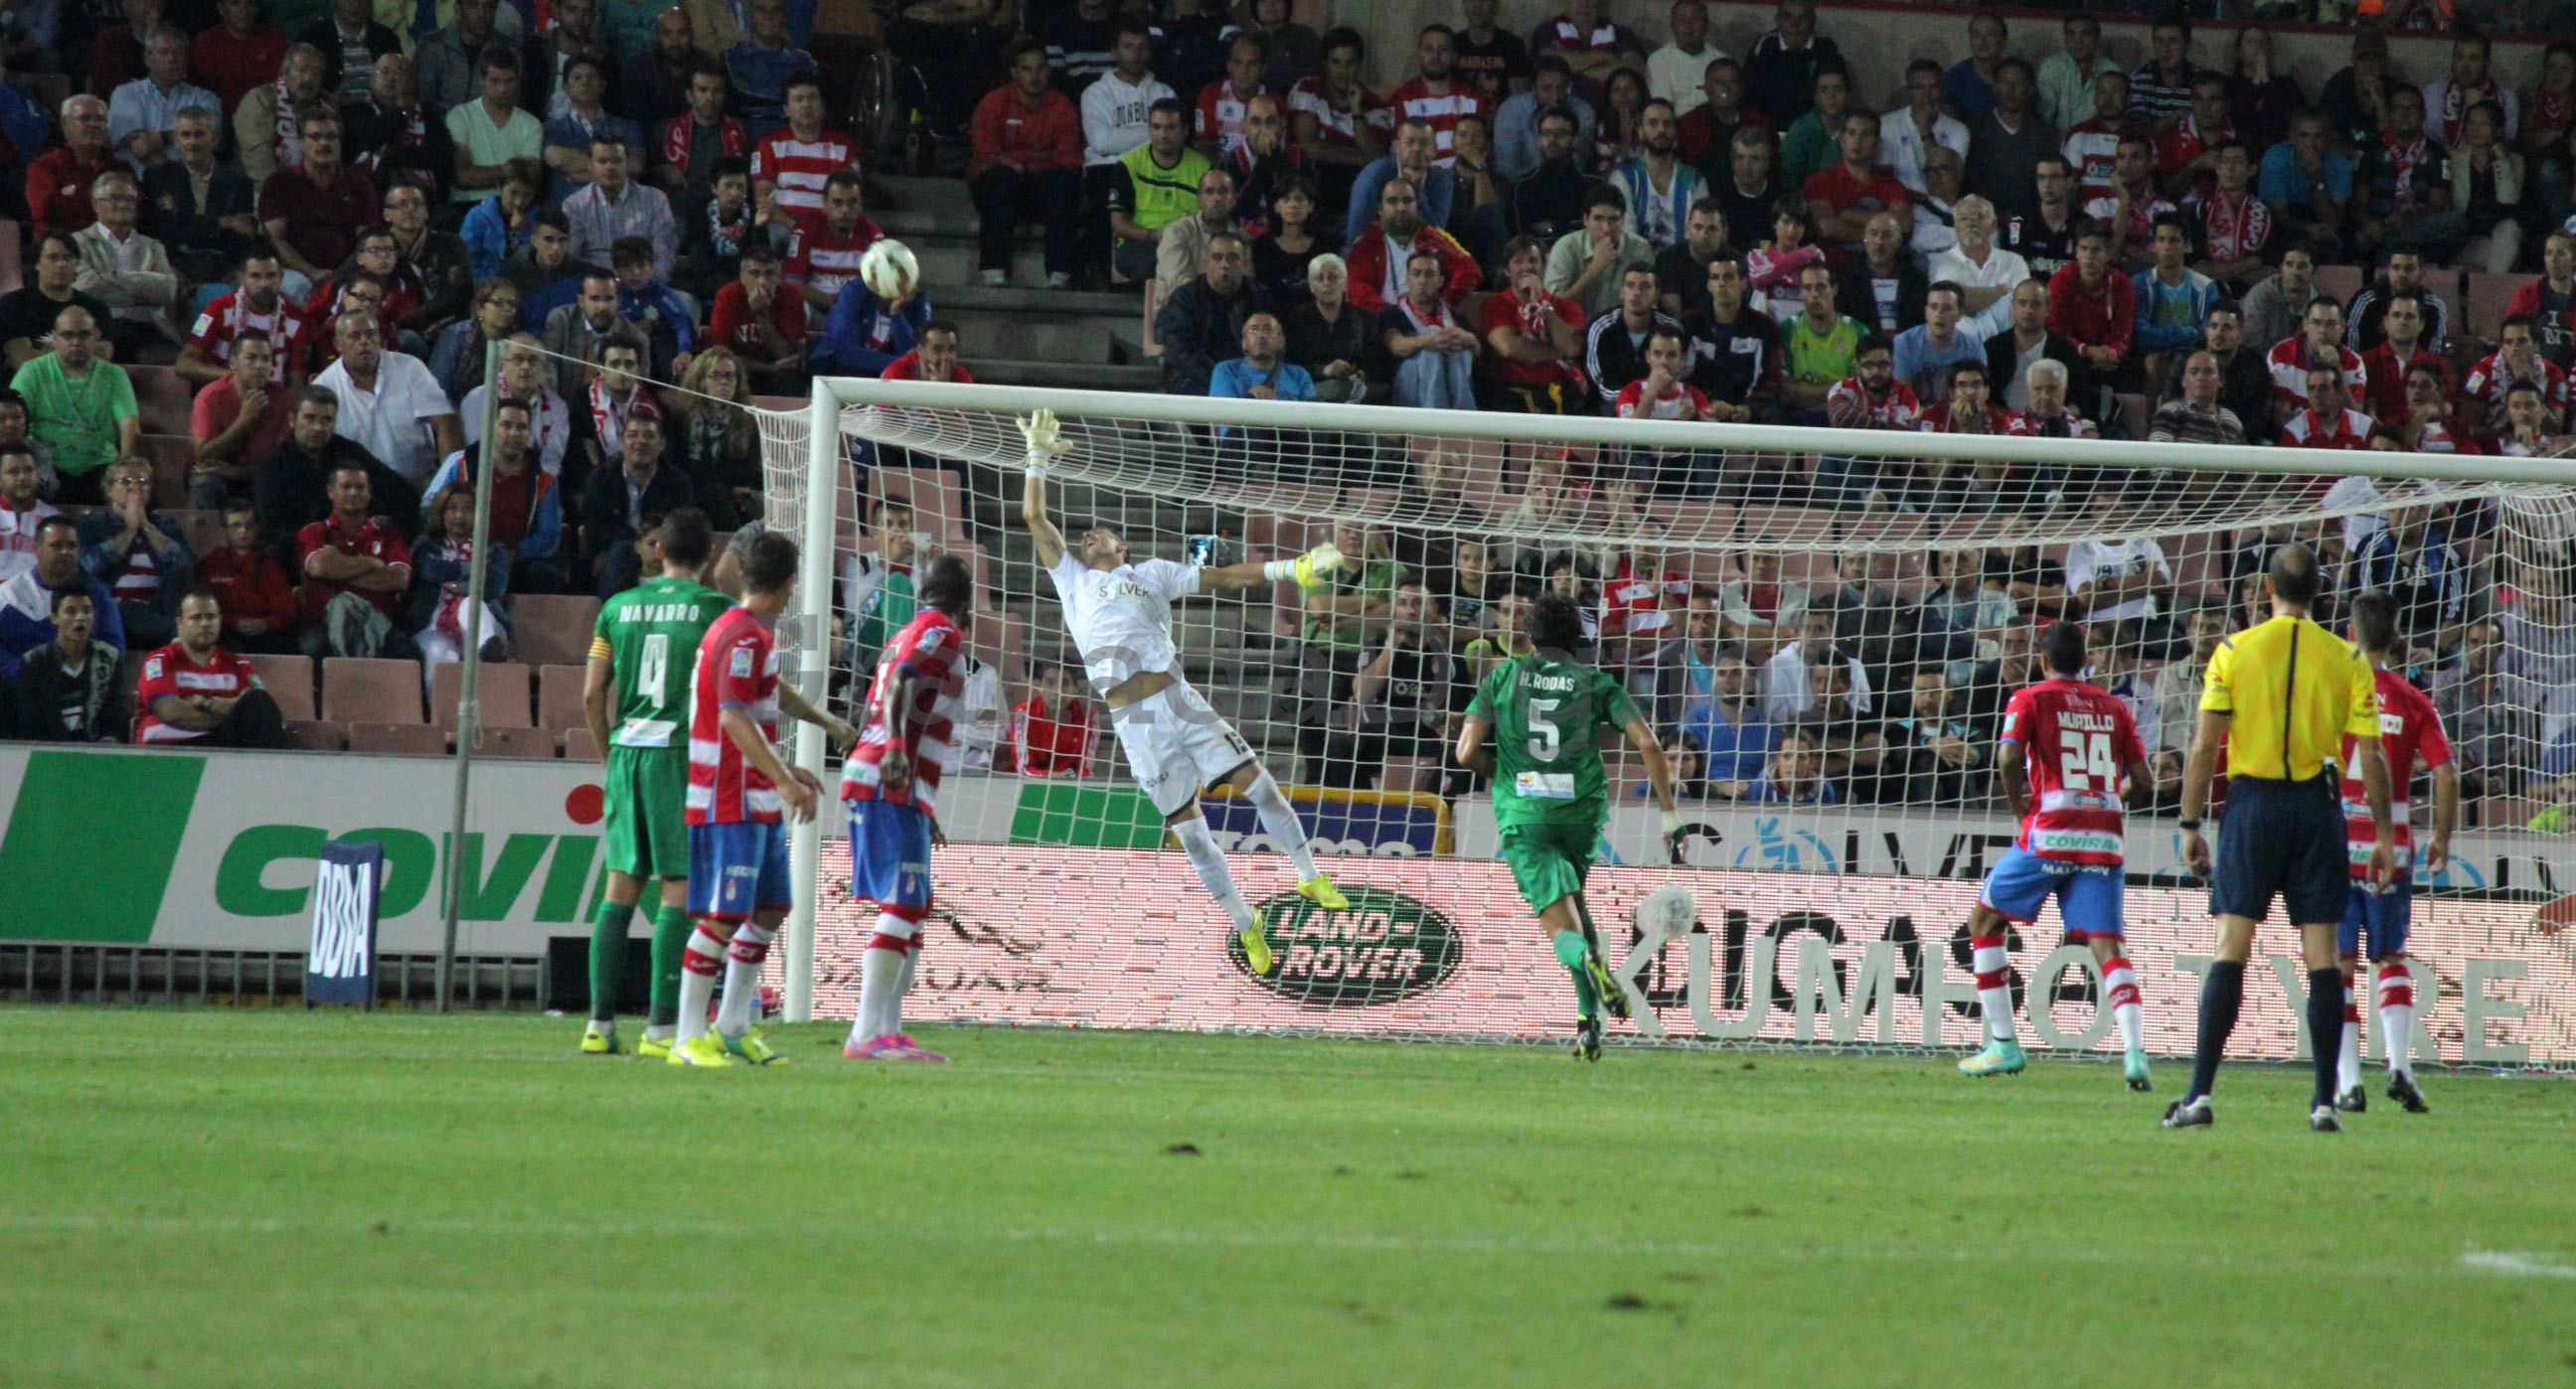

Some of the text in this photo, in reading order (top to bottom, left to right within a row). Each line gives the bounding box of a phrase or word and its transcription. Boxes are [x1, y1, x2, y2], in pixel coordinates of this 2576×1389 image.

[619, 603, 700, 623] NAVARRO
[637, 633, 669, 708] 4
[1528, 697, 1560, 763] 5
[2057, 710, 2115, 731] MURILLO
[2059, 730, 2117, 793] 24
[215, 824, 658, 924] COVI
[308, 859, 371, 979] BBVA
